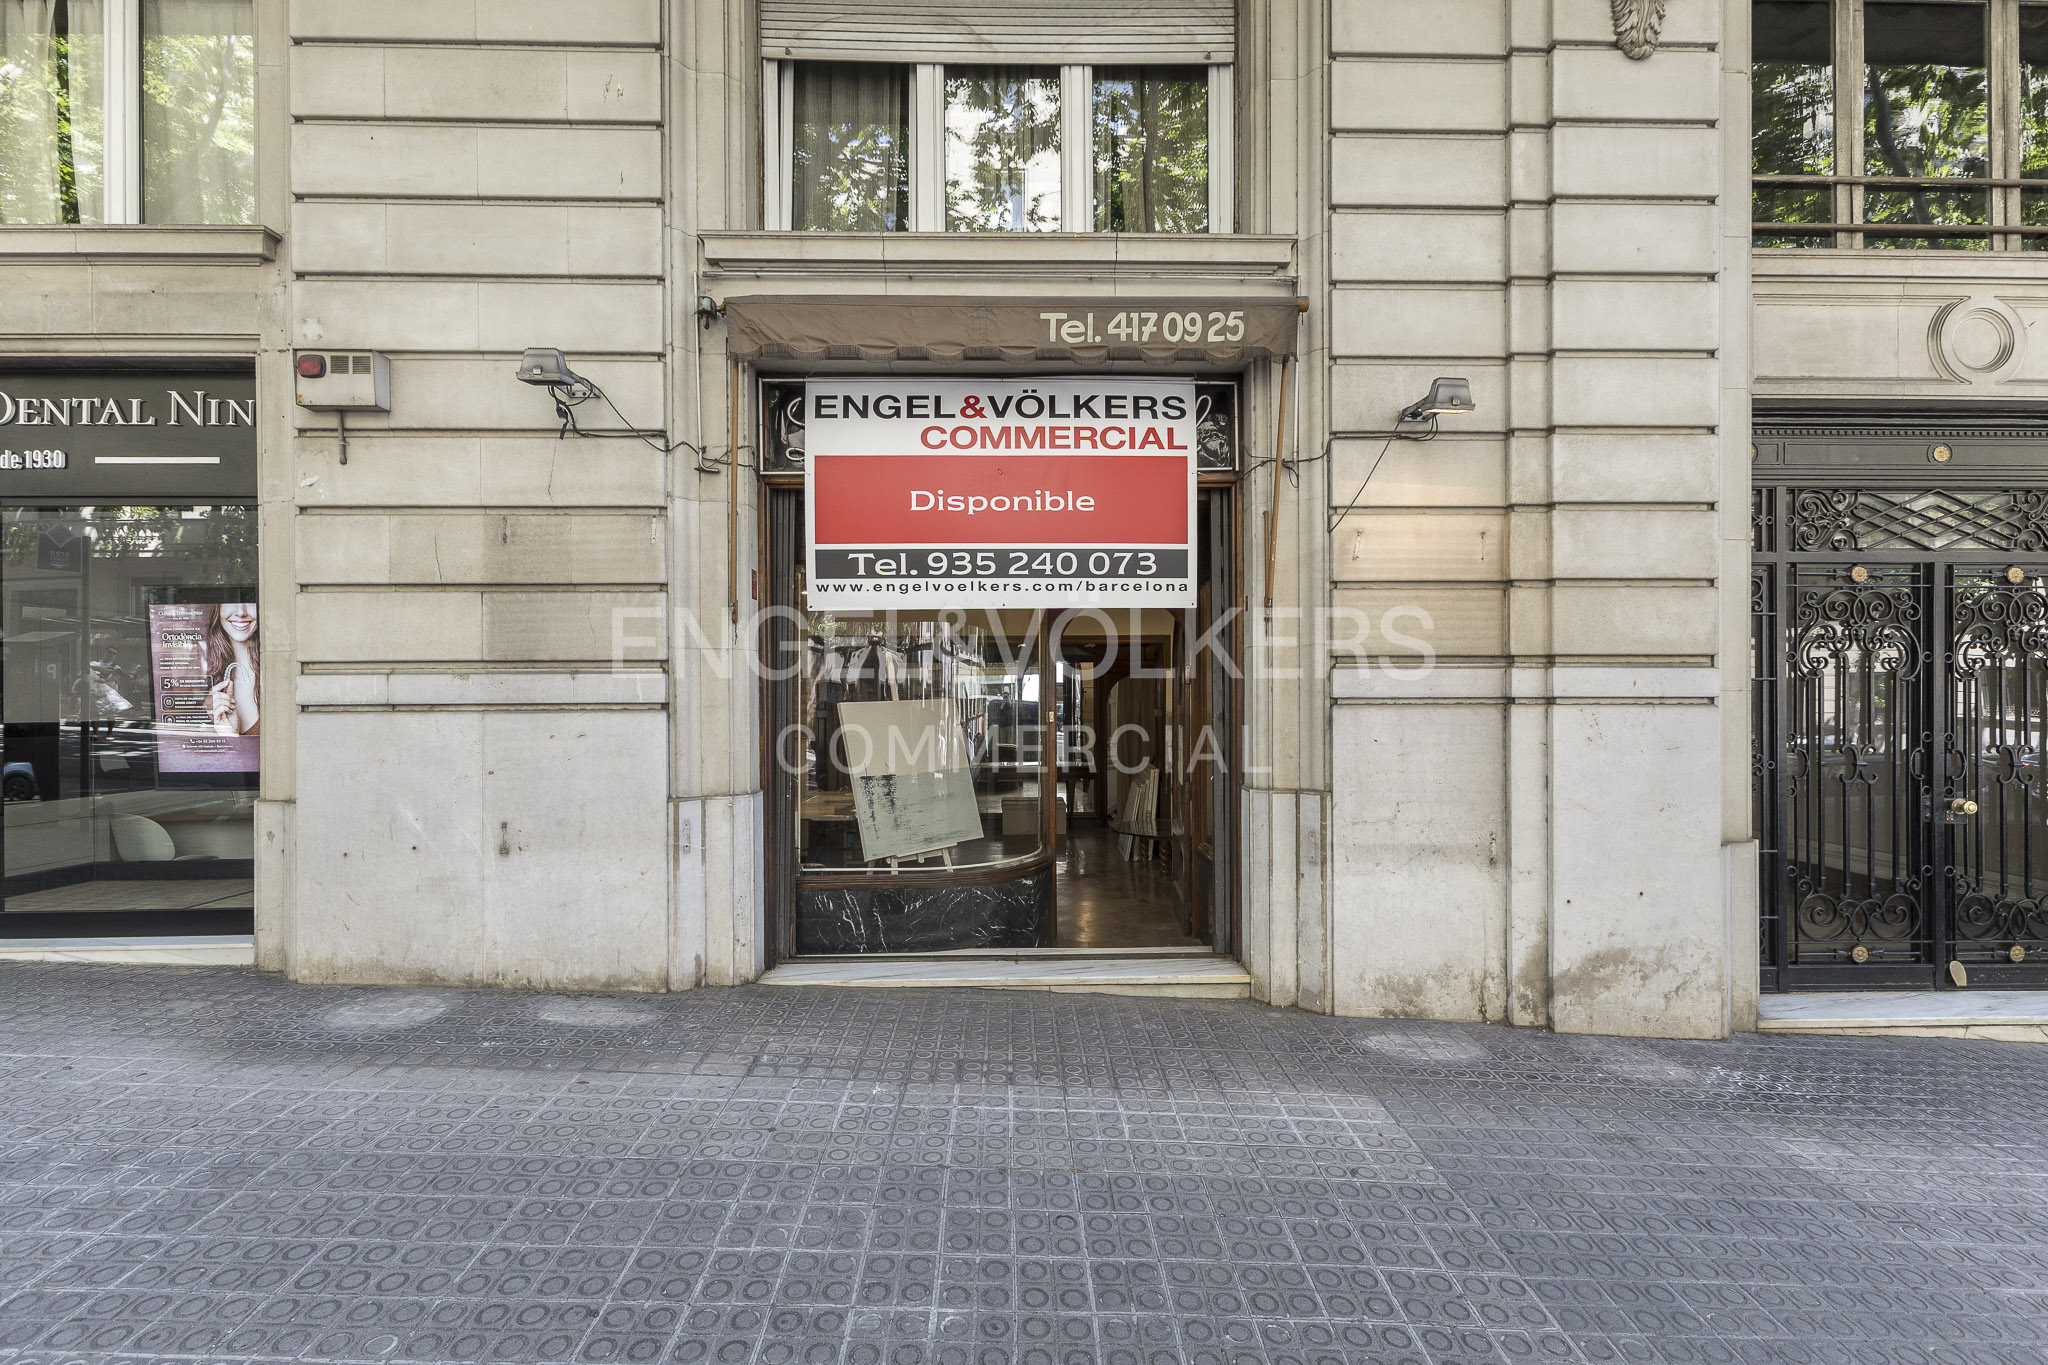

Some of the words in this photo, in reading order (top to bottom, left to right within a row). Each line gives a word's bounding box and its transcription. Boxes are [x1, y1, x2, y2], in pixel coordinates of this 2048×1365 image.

[1040, 312, 1102, 343] Tel.
[1107, 312, 1158, 342] 417
[1162, 311, 1203, 343] 09
[1207, 311, 1245, 342] 25
[814, 389, 1188, 420] ENGEL&VÖLKERS
[920, 425, 1188, 451] COMMERCIAL
[23, 449, 66, 470] 1930
[909, 489, 1096, 515] Disponible
[847, 552, 918, 577] Tel.
[926, 551, 997, 576] 935
[1008, 551, 1079, 576] 240
[1088, 551, 1158, 576] 073
[816, 580, 1189, 594] www.engelvoelkers.com/barcelona
[163, 678, 179, 689] 5%
